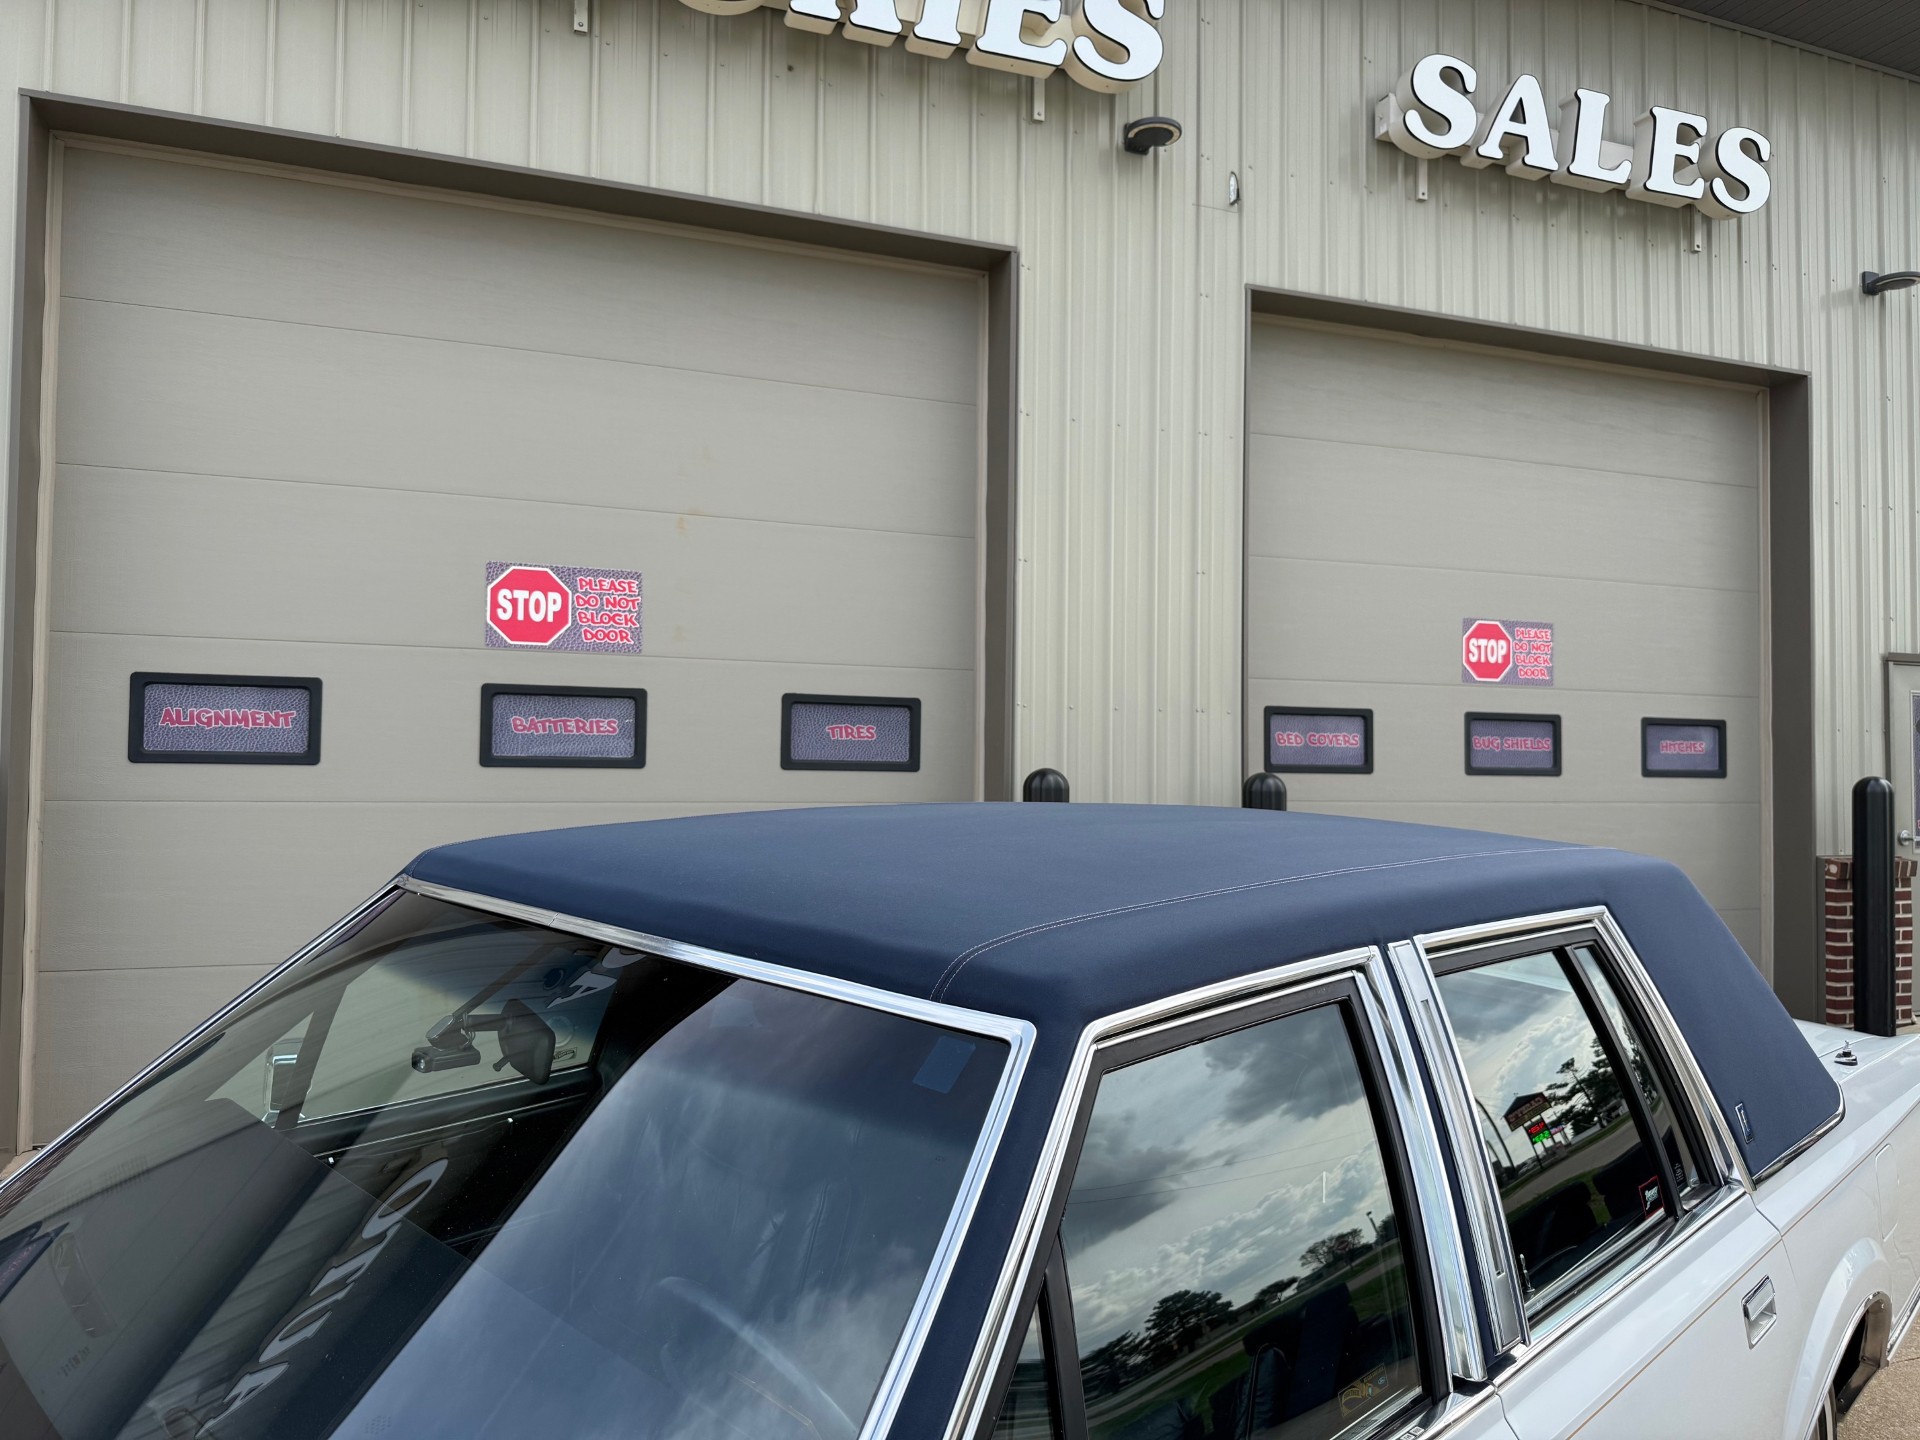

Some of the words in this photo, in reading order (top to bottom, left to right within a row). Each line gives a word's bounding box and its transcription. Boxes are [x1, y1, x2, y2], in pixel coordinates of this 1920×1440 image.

[1403, 53, 1771, 214] SALES
[577, 577, 639, 594] PLEASE
[496, 588, 563, 622] STOP
[574, 594, 600, 609] DO
[604, 596, 641, 611] NOT
[577, 611, 640, 628] BLOCK
[582, 628, 634, 644] DOOR
[1514, 627, 1551, 640] PLEASE
[1468, 638, 1507, 664] STOP
[1513, 641, 1528, 651] DO
[1531, 641, 1552, 654] NOT
[1514, 653, 1552, 666] BLOCK
[1518, 667, 1549, 680] DOOR
[159, 706, 296, 729] ALIGNMENT
[511, 716, 618, 736] BATTERIES
[826, 724, 877, 741] TIRES
[1275, 731, 1304, 747] BED
[1306, 731, 1360, 748] COVERS
[1472, 735, 1501, 752] BUG
[1503, 737, 1552, 752] SHIELDS
[1660, 740, 1706, 755] HITCHES
